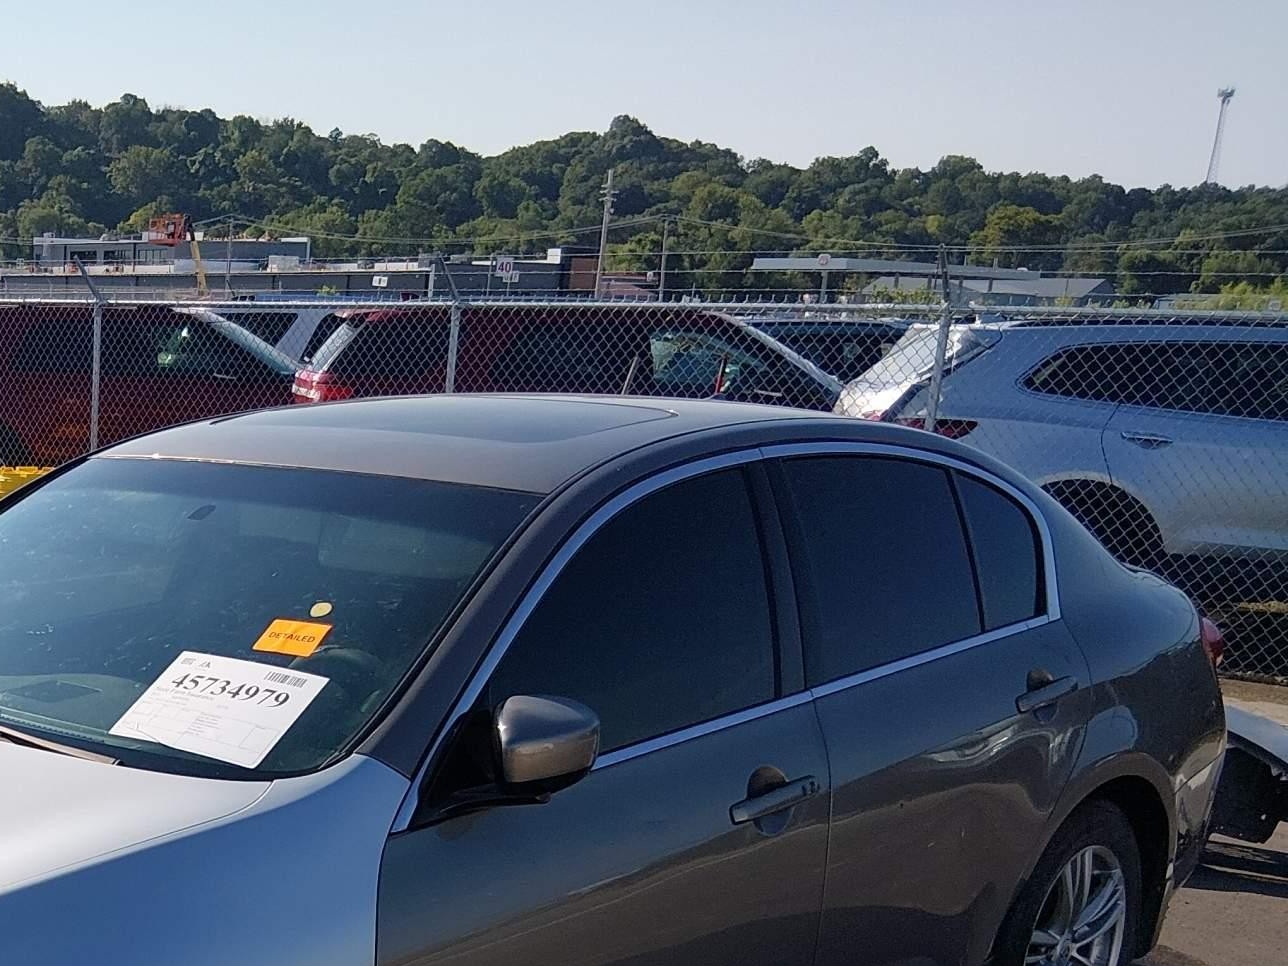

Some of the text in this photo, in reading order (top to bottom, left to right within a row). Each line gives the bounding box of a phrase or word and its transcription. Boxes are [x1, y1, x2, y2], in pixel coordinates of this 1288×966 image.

[498, 261, 511, 273] 40
[268, 631, 316, 643] DETAILED
[171, 673, 290, 710] 45734979
